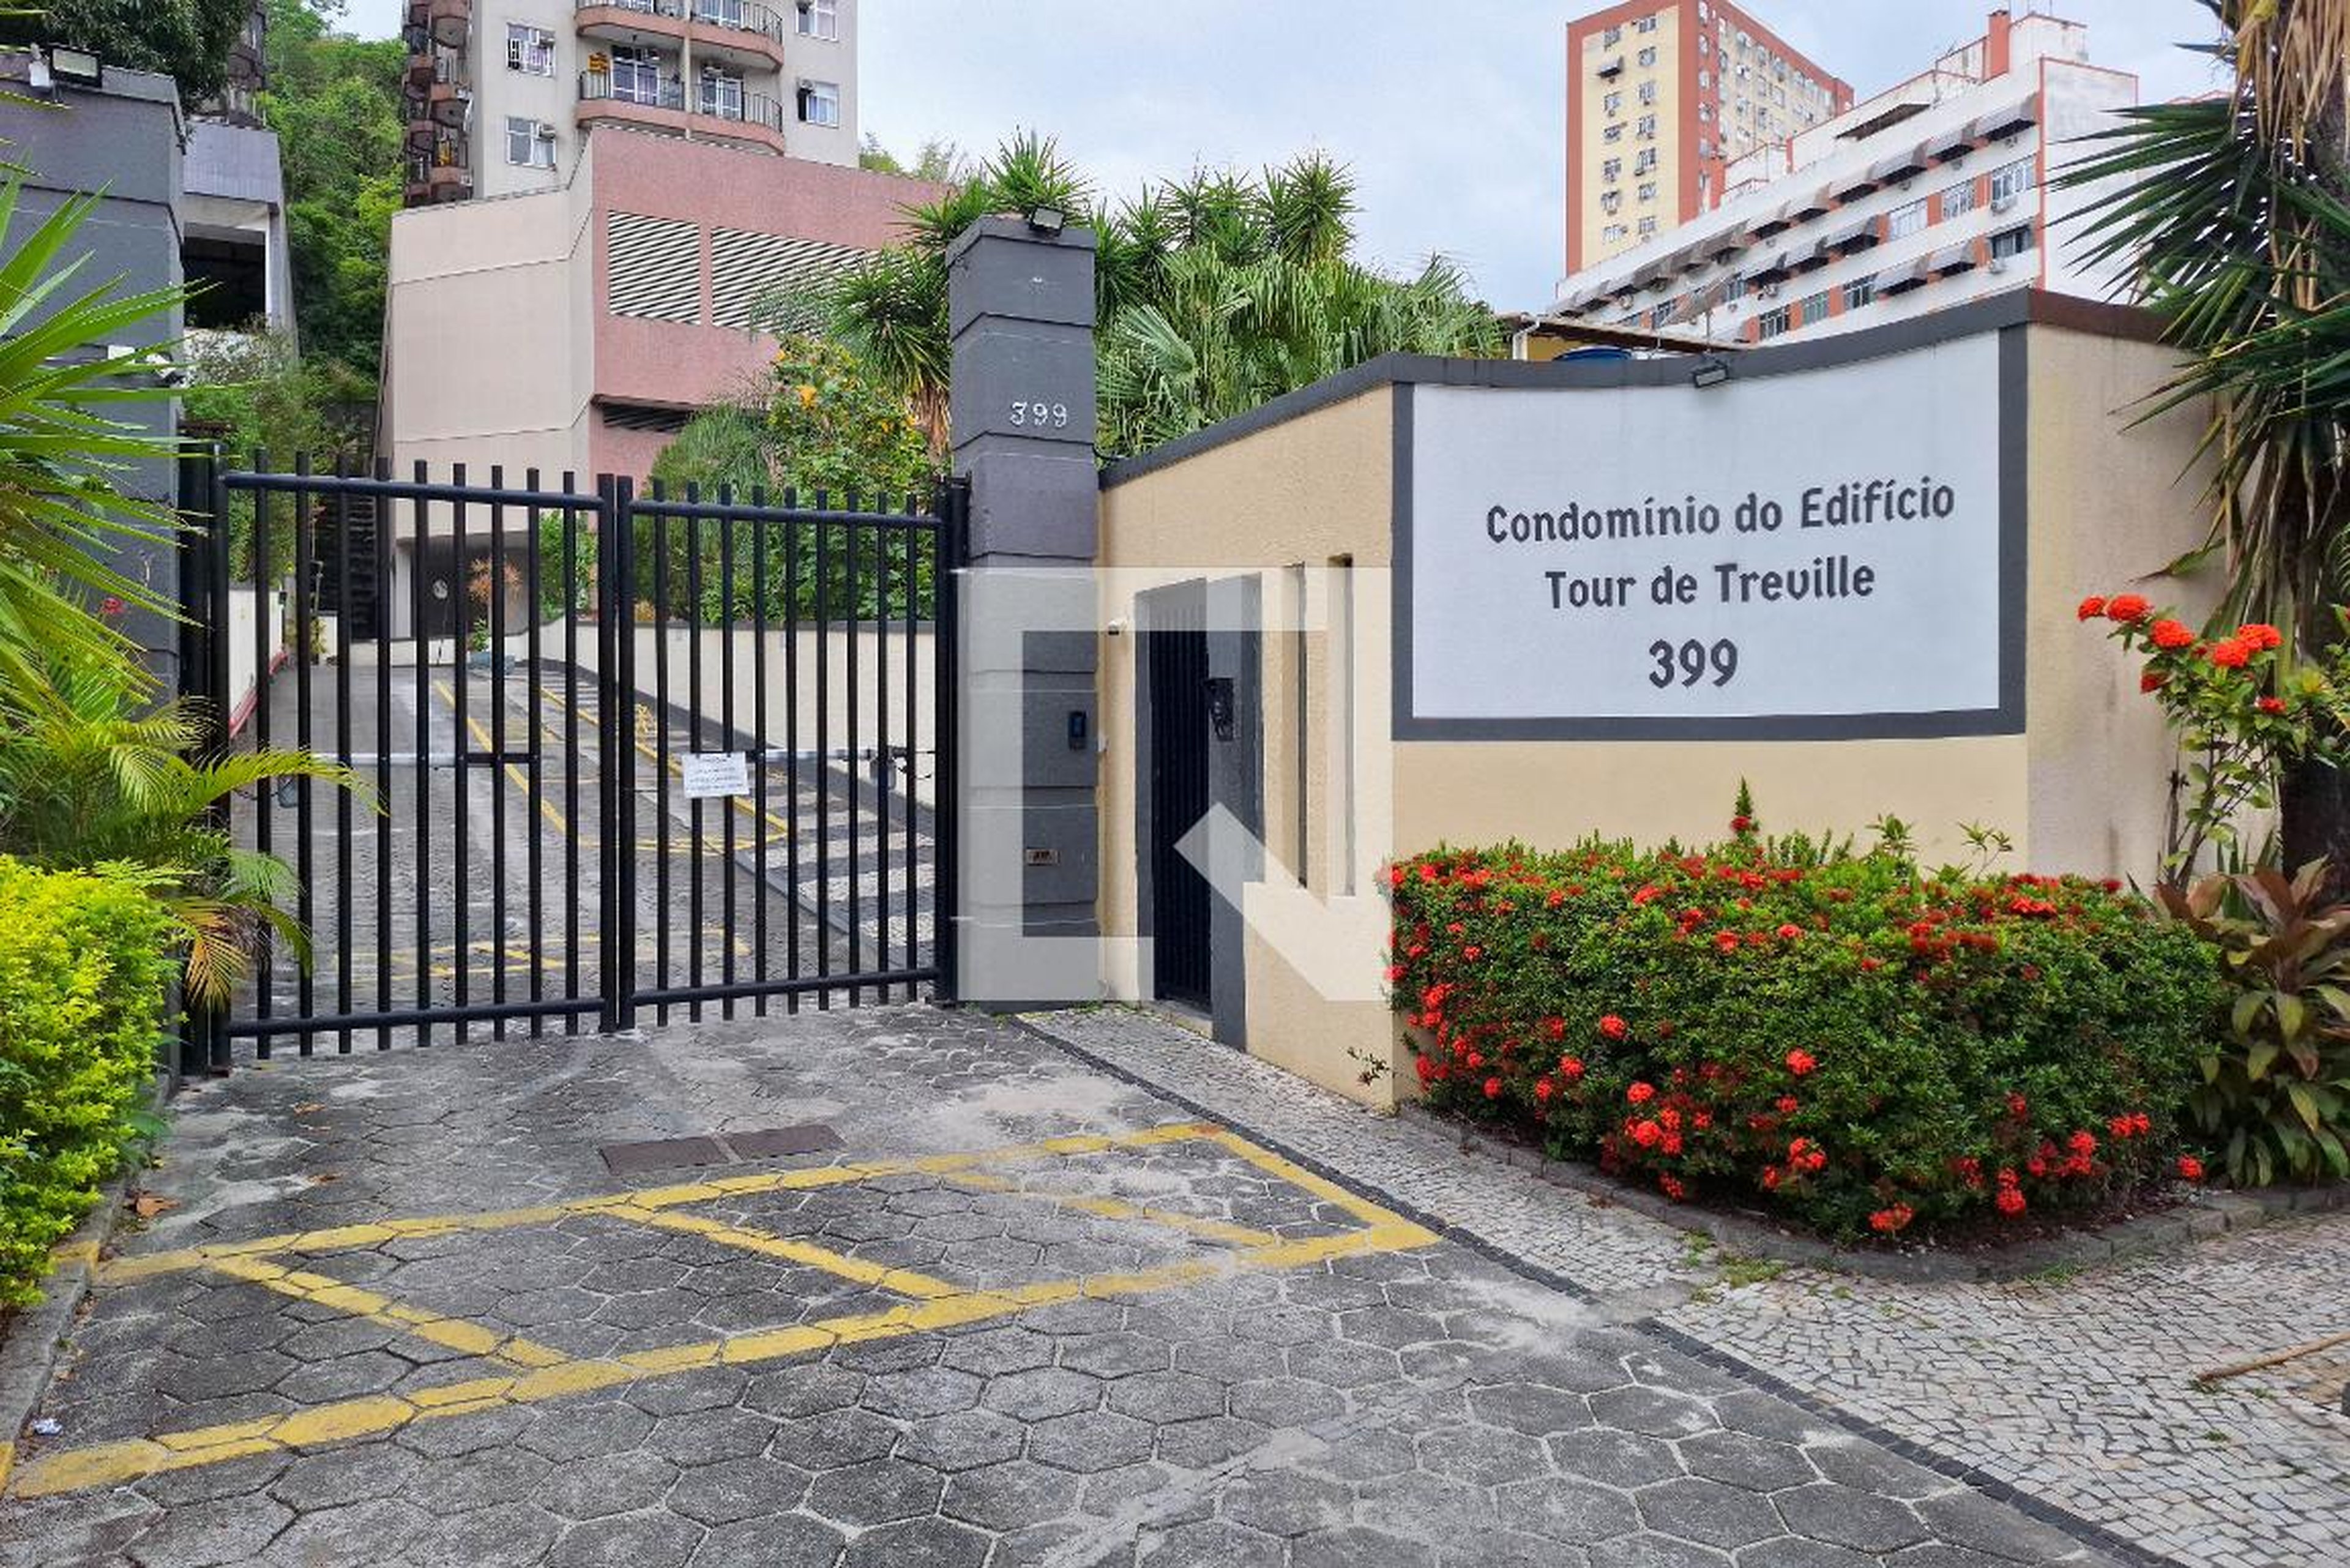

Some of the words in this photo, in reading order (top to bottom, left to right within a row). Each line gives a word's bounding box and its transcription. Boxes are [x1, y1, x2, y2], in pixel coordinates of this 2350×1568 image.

[1009, 401, 1069, 428] 399
[1486, 495, 1721, 544] Condomínio
[1734, 491, 1783, 534] do
[1800, 475, 1955, 529] Edifício
[1545, 569, 1638, 609] Tour
[1651, 564, 1698, 605] de
[1714, 554, 1876, 603] Treville
[1648, 638, 1739, 689] 399
